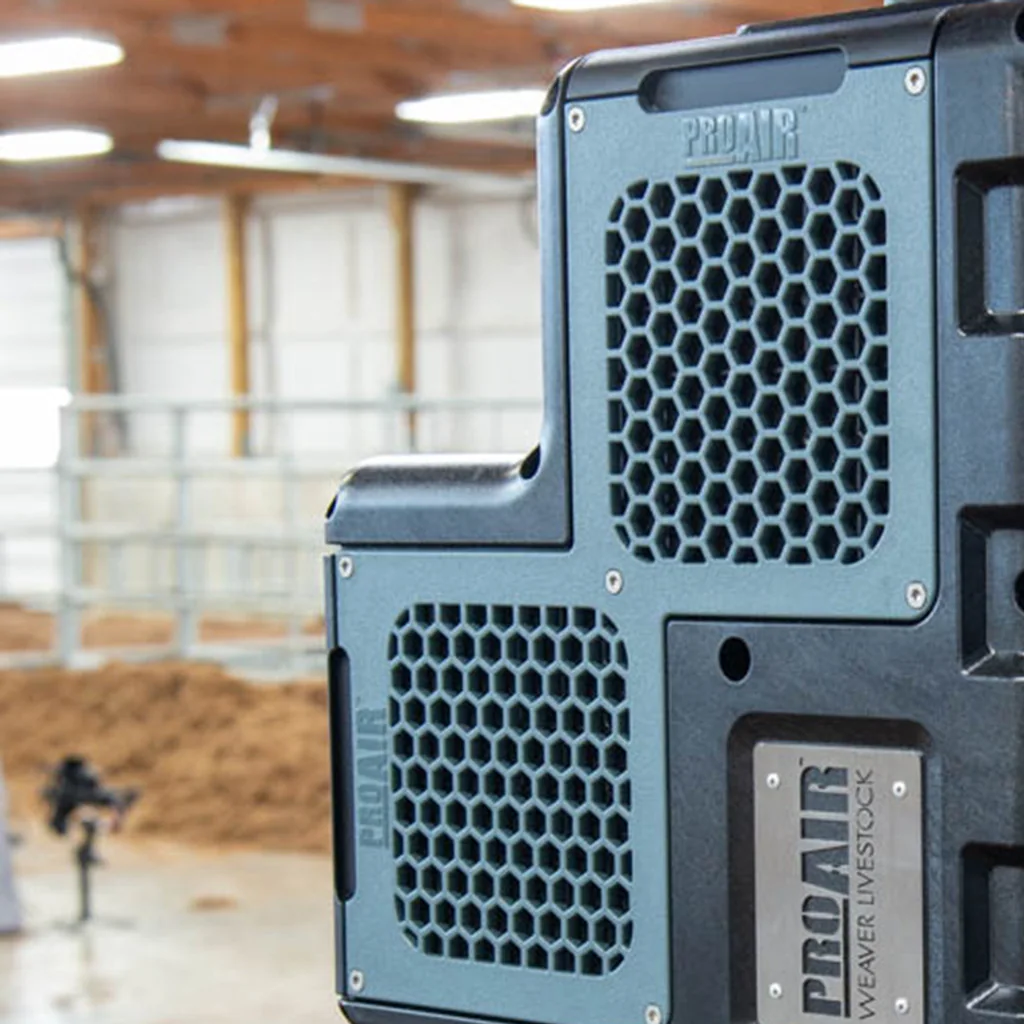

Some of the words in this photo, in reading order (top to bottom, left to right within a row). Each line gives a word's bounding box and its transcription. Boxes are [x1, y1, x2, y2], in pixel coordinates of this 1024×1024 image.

[682, 108, 799, 165] PROAIR
[356, 708, 388, 848] PROAIR
[854, 768, 876, 906] LIVESTOCK
[800, 765, 849, 1017] PROAIR
[855, 915, 876, 1020] WEAVER
